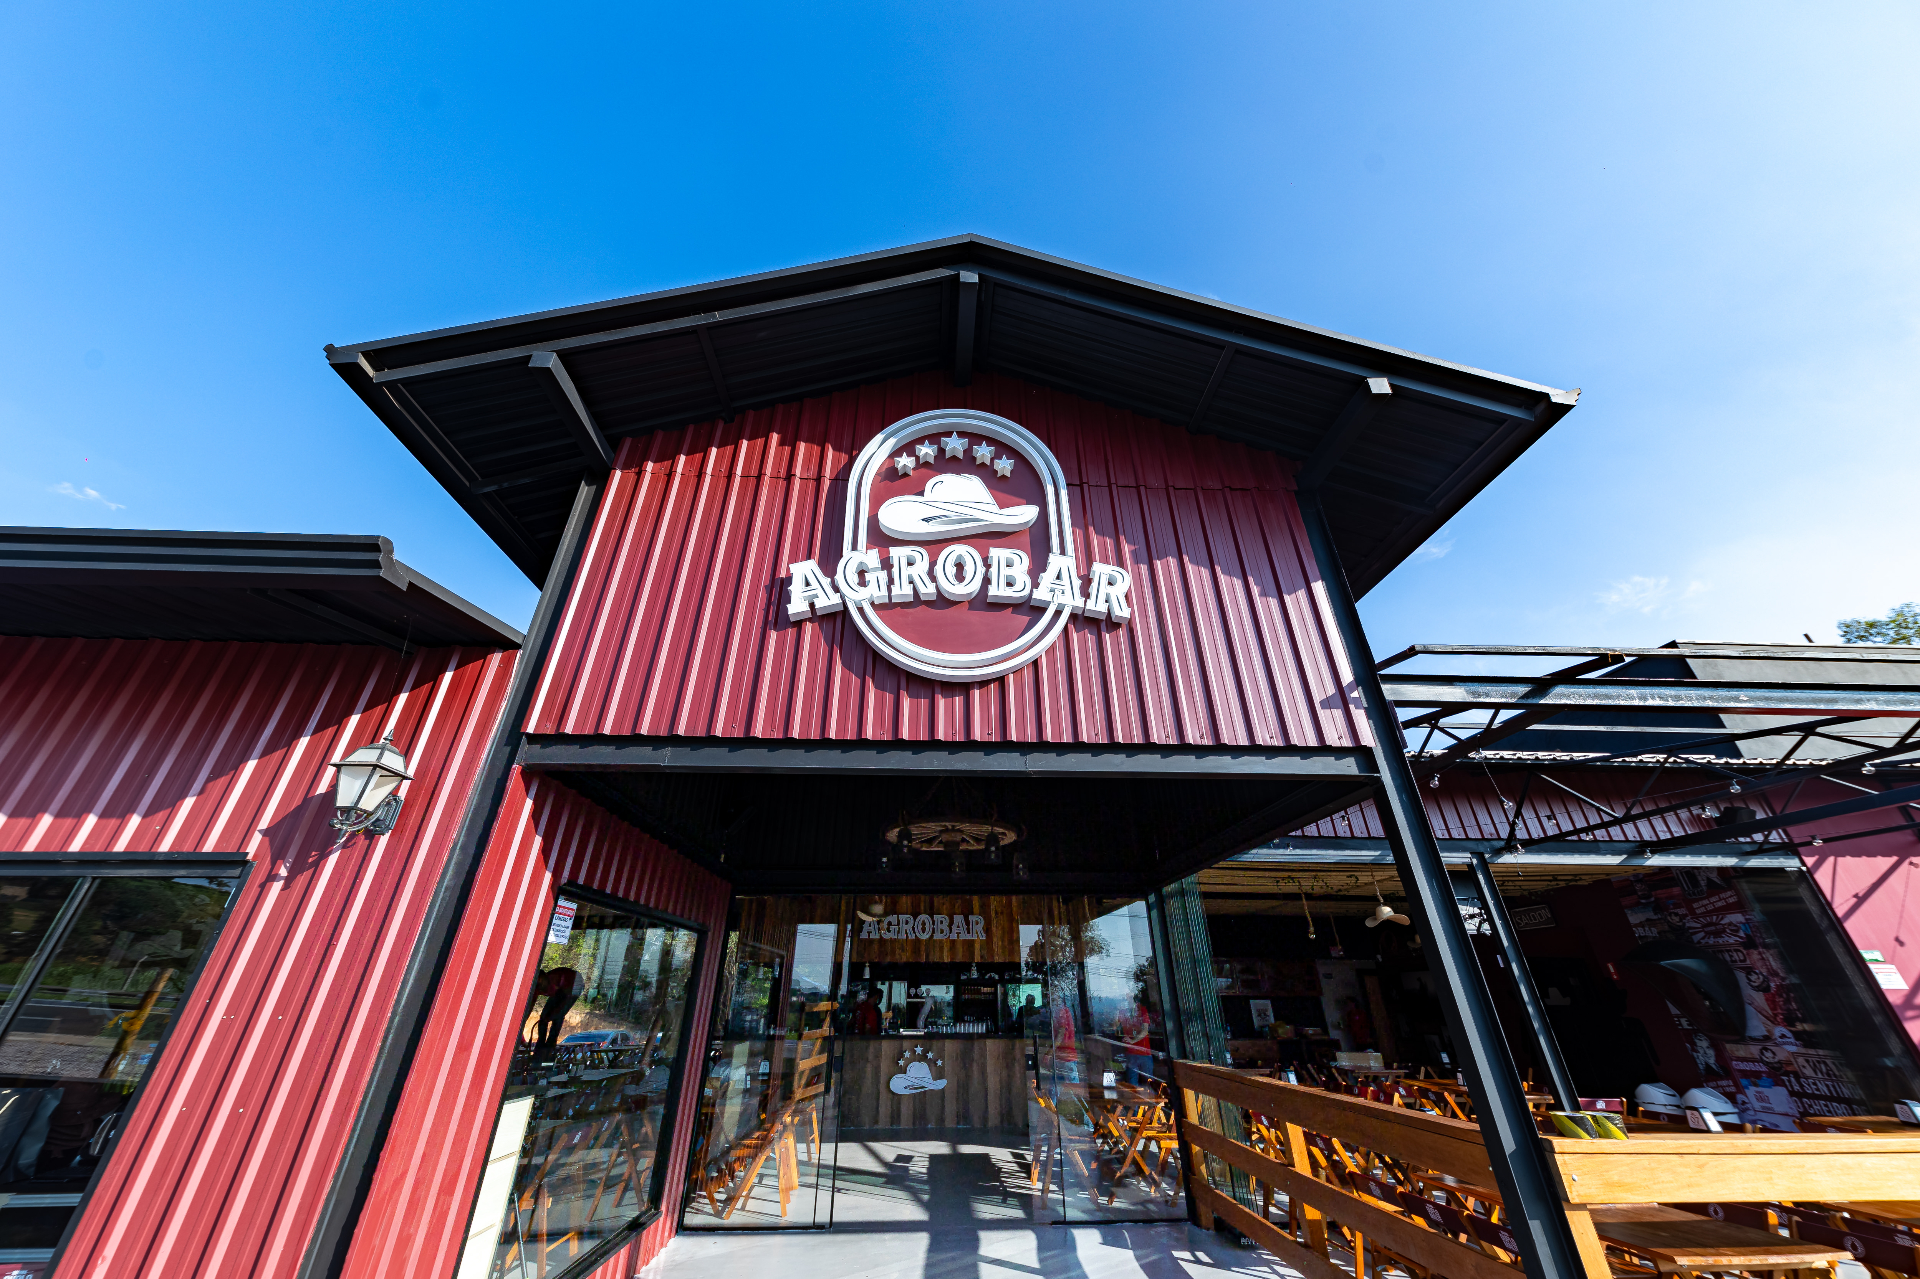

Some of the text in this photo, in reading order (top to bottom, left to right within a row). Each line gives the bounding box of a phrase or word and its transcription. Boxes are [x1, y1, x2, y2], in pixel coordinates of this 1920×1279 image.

[787, 544, 1132, 624] AGROBAR
[860, 914, 986, 940] AGROBAR
[1515, 907, 1551, 927] SALOON
[1802, 1098, 1853, 1117] CHEIRO
